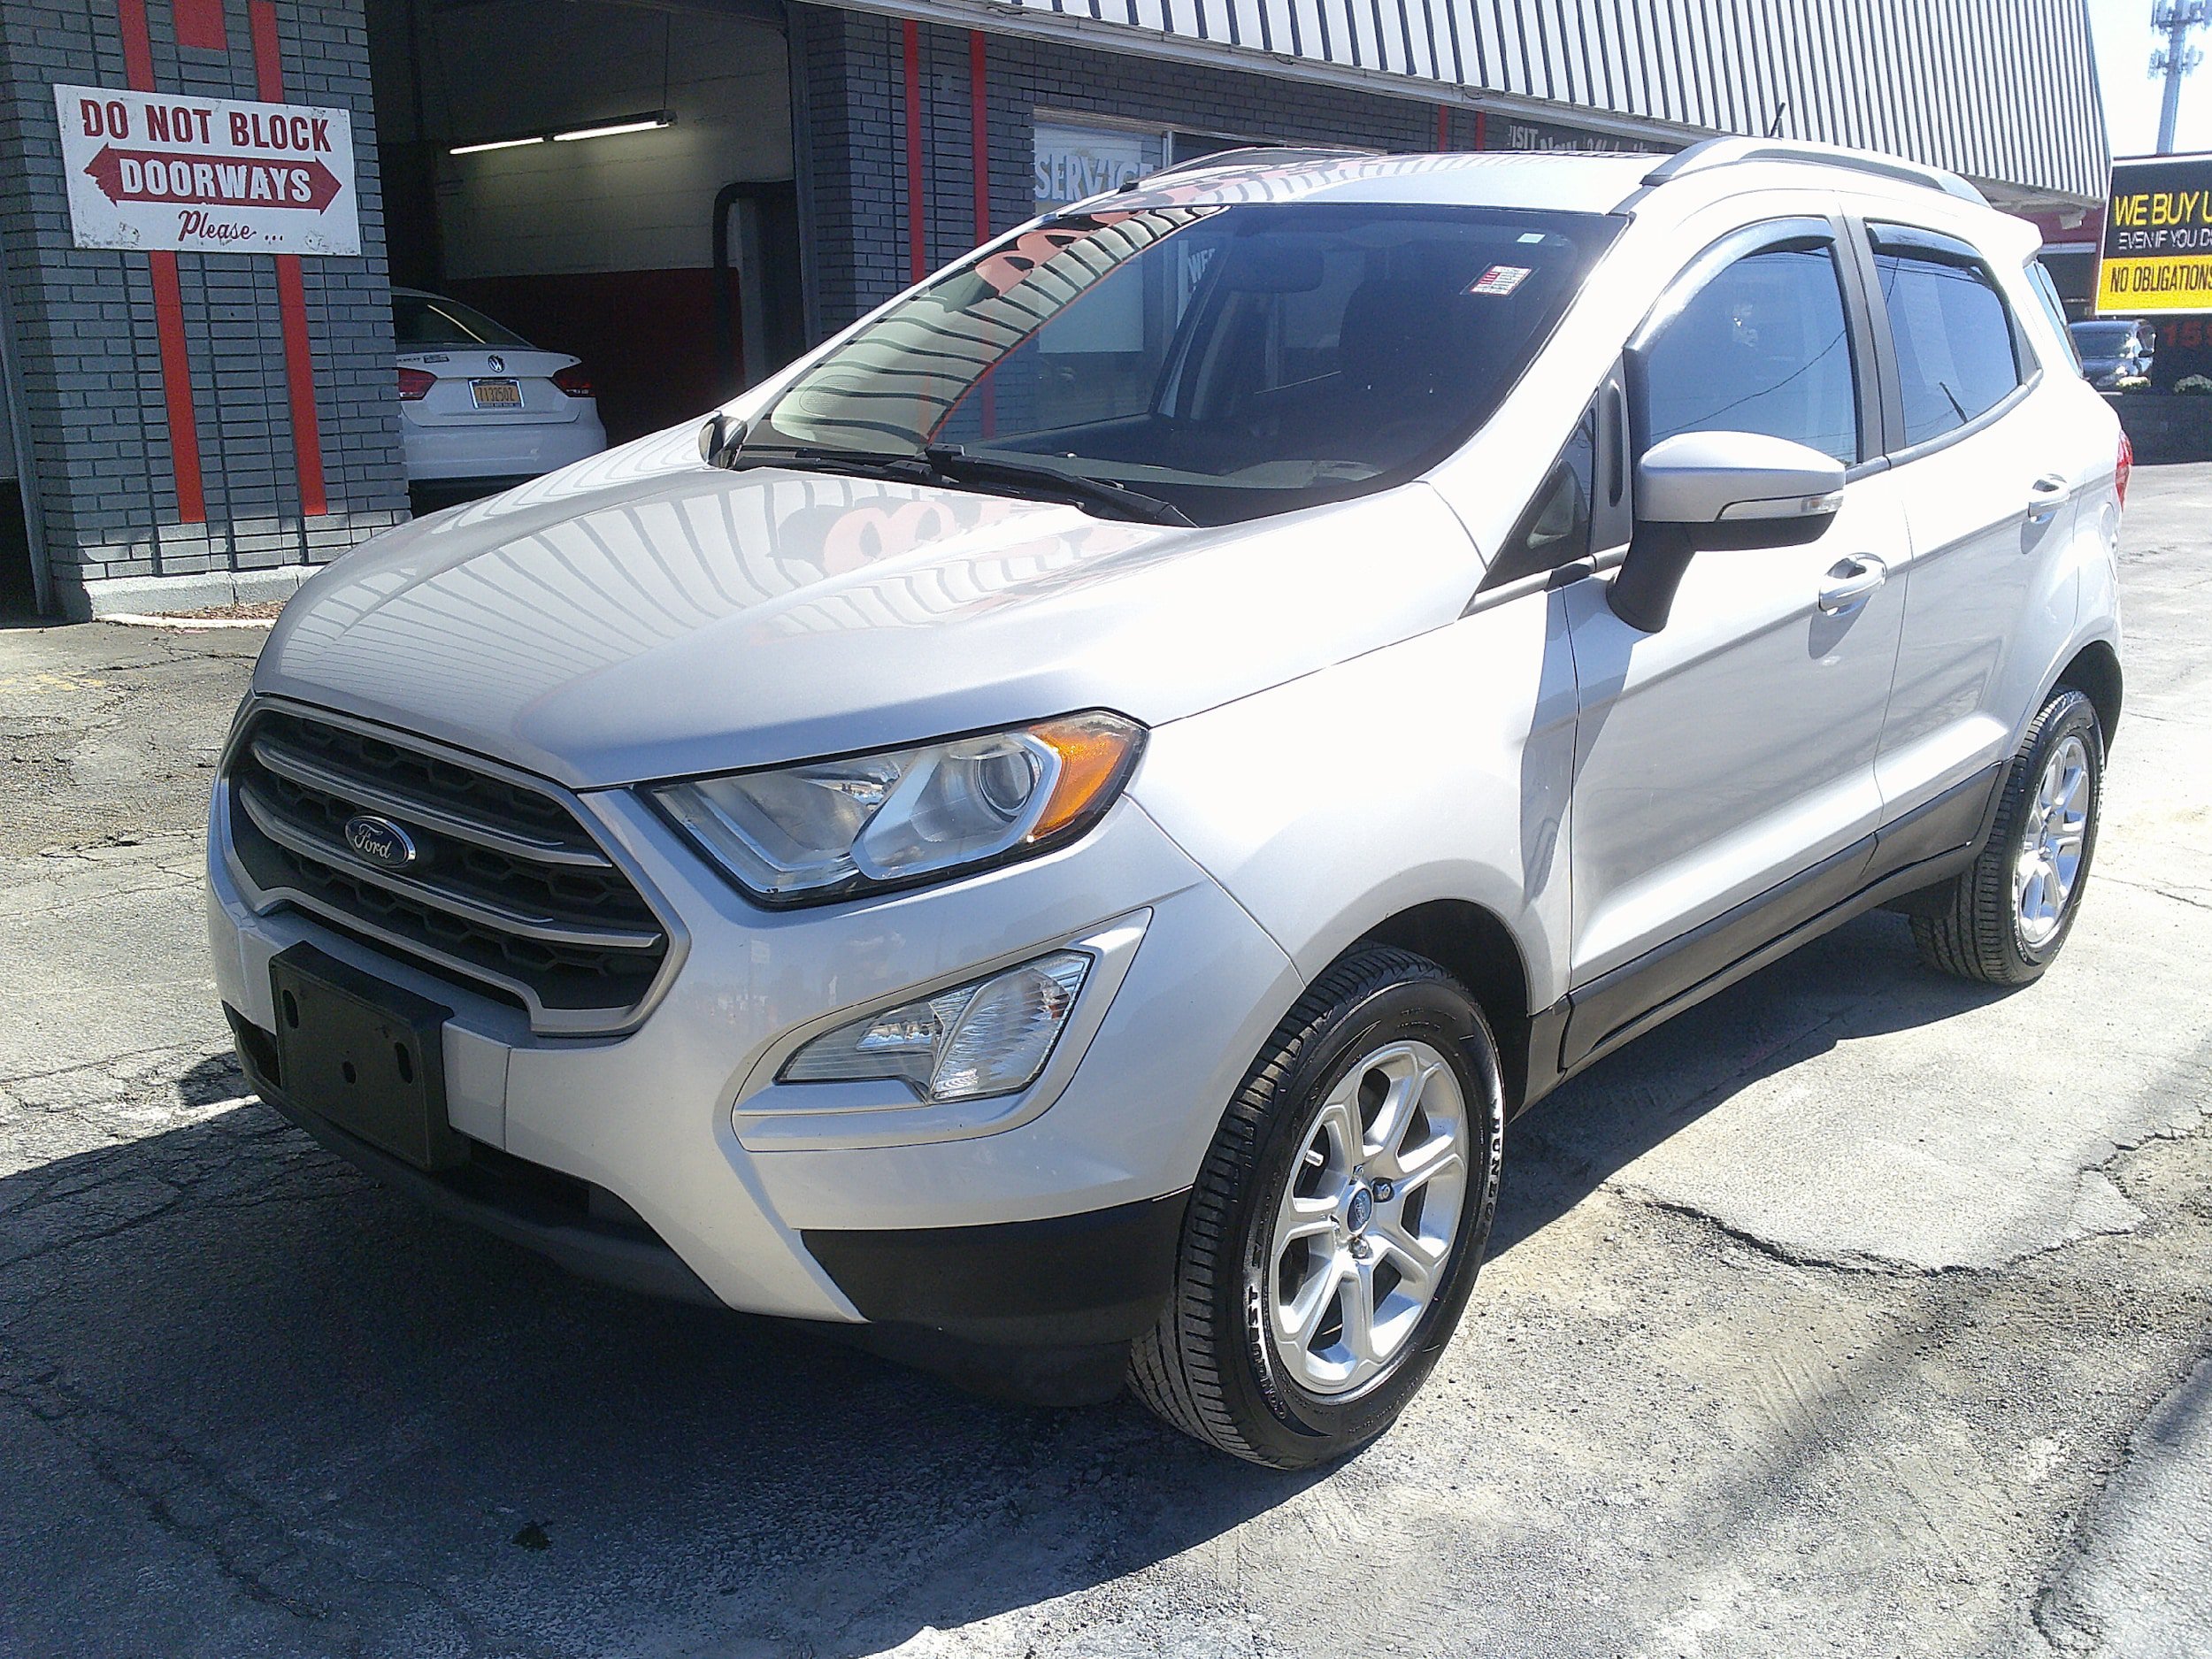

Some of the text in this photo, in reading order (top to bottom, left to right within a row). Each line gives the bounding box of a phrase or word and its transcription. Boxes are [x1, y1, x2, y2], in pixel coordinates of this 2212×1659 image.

[80, 98, 332, 152] DO NOT BLOCK
[119, 157, 312, 203] DOORWAYS
[177, 210, 257, 242] Please
[2115, 194, 2149, 226] WE
[2152, 190, 2200, 225] BUY
[2118, 231, 2153, 250] EVEN
[2154, 229, 2168, 248] IF
[2170, 228, 2198, 248] YOU
[2110, 264, 2212, 293] NO OBLIGATIONS
[354, 823, 392, 859] Ford
